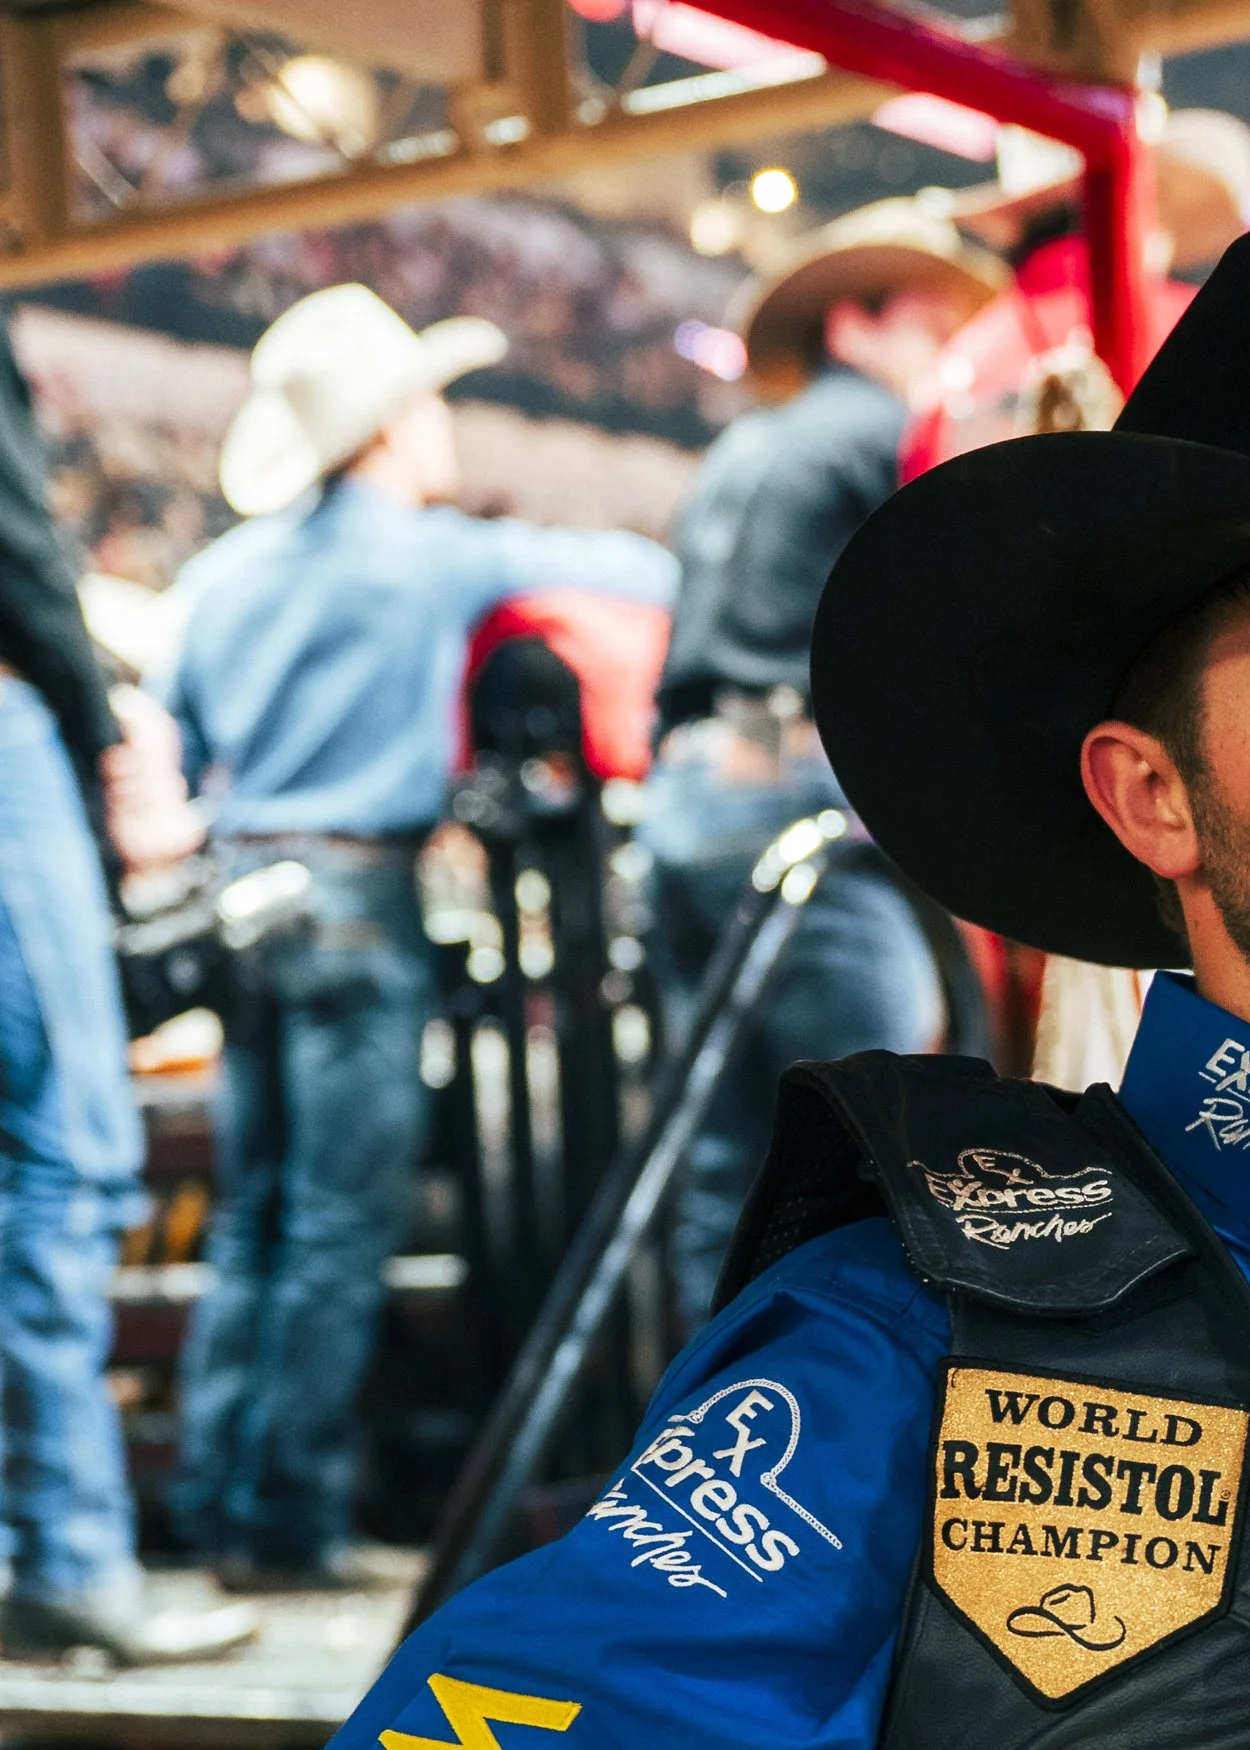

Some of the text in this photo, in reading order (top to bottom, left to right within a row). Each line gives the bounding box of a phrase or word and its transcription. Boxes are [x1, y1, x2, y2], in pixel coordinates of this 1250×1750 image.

[955, 1210, 1113, 1250] Ranches
[984, 1388, 1203, 1447] WORLD
[939, 1439, 1231, 1527] RESISTOL
[940, 1517, 1222, 1575] CHAMPION
